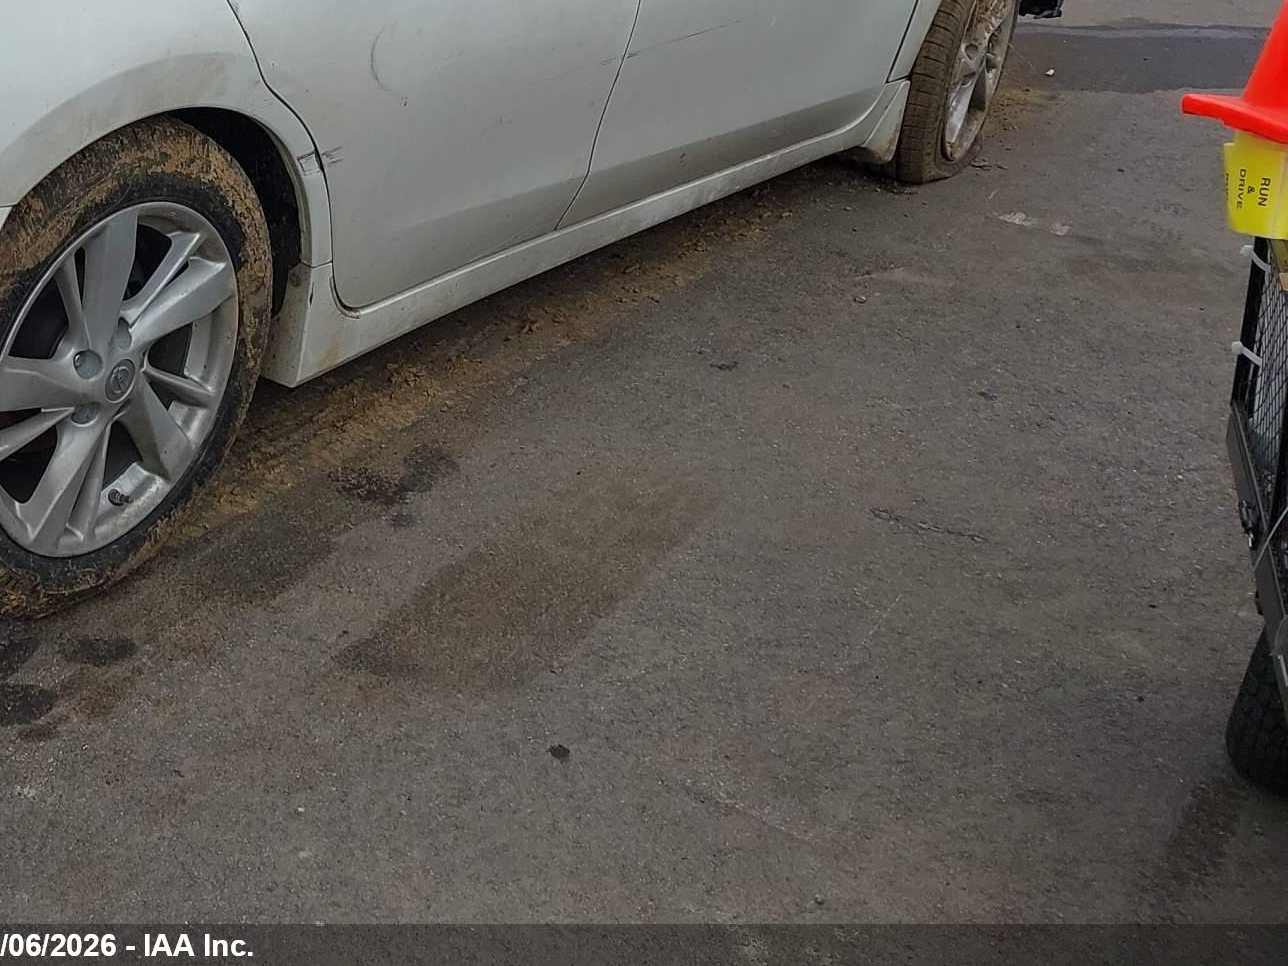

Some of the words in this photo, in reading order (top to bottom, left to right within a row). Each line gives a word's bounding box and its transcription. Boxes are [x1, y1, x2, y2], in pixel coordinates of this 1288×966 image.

[1236, 168, 1247, 210] DRIVE
[1247, 185, 1256, 194] &
[1257, 177, 1272, 207] RUN
